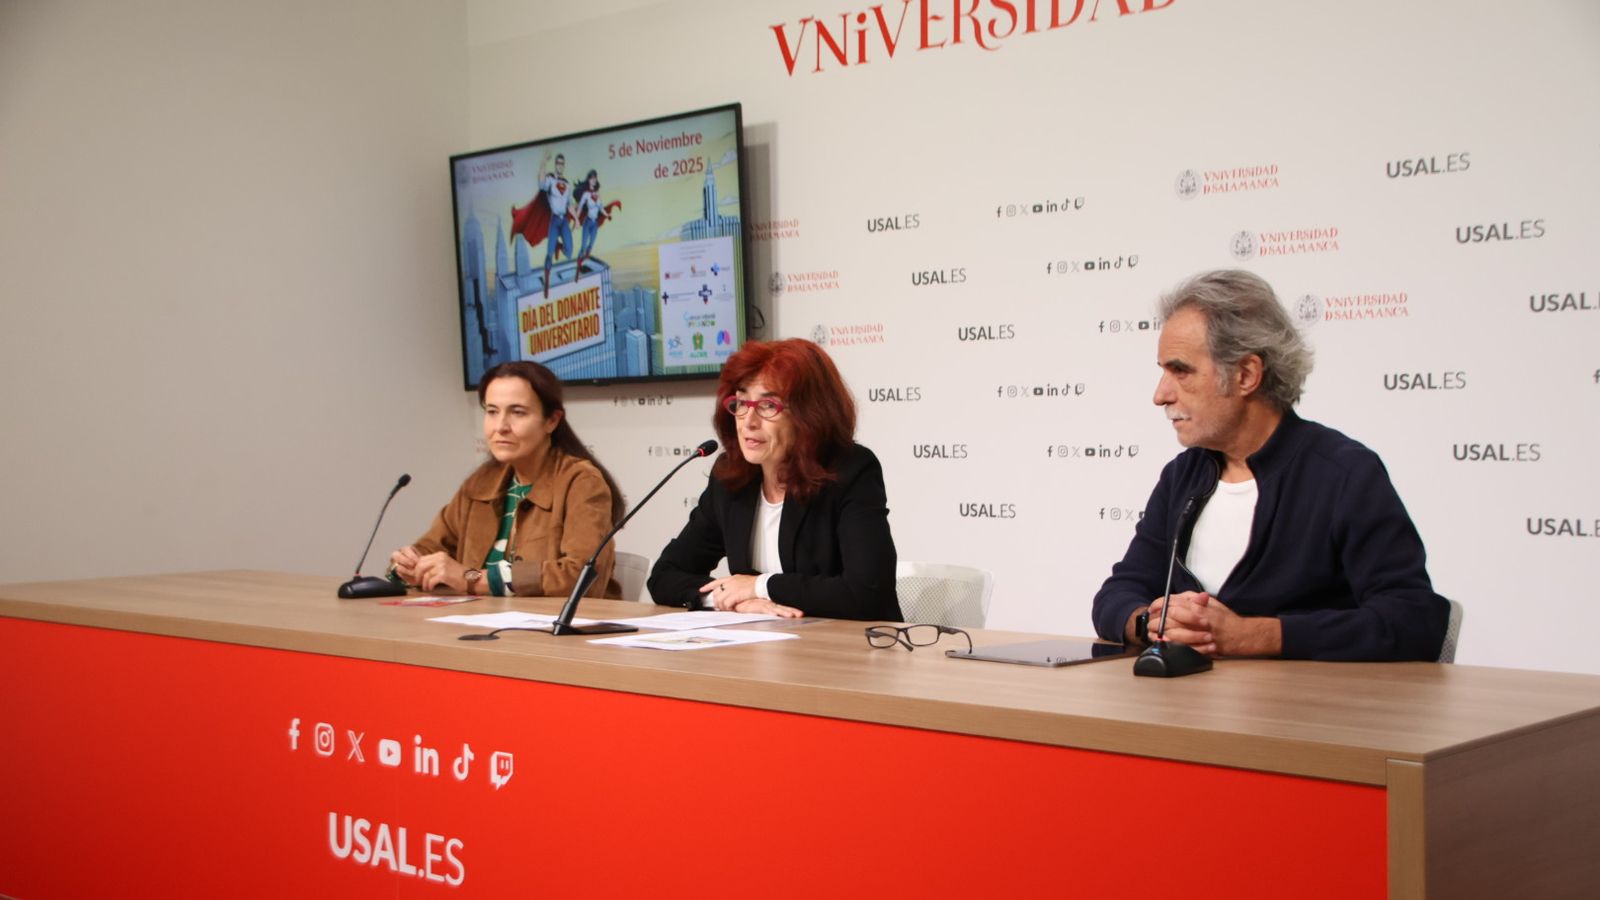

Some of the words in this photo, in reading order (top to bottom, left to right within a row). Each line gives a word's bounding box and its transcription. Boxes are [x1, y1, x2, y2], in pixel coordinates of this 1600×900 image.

[608, 144, 615, 159] 5
[618, 142, 632, 158] de
[636, 131, 703, 154] Noviembre
[654, 164, 669, 179] de
[672, 157, 704, 176] 2025
[1386, 152, 1471, 179] USAL.ES
[867, 214, 920, 233] USAL.ES
[1456, 219, 1546, 244] USAL.ES
[912, 268, 967, 286] USAL.ES
[539, 303, 557, 328] DEL
[555, 286, 601, 323] DONANTE
[1529, 292, 1600, 313] USAL.
[528, 313, 600, 357] UNIVERSITARIO
[958, 324, 1016, 342] USAL.ES
[1384, 371, 1467, 391] USAL.ES
[868, 386, 922, 402] USAL.ES
[913, 444, 968, 460] USAL.ES
[1453, 443, 1541, 462] USAL.ES
[959, 502, 1017, 519] USAL.ES
[328, 811, 465, 887] USAL.ES
